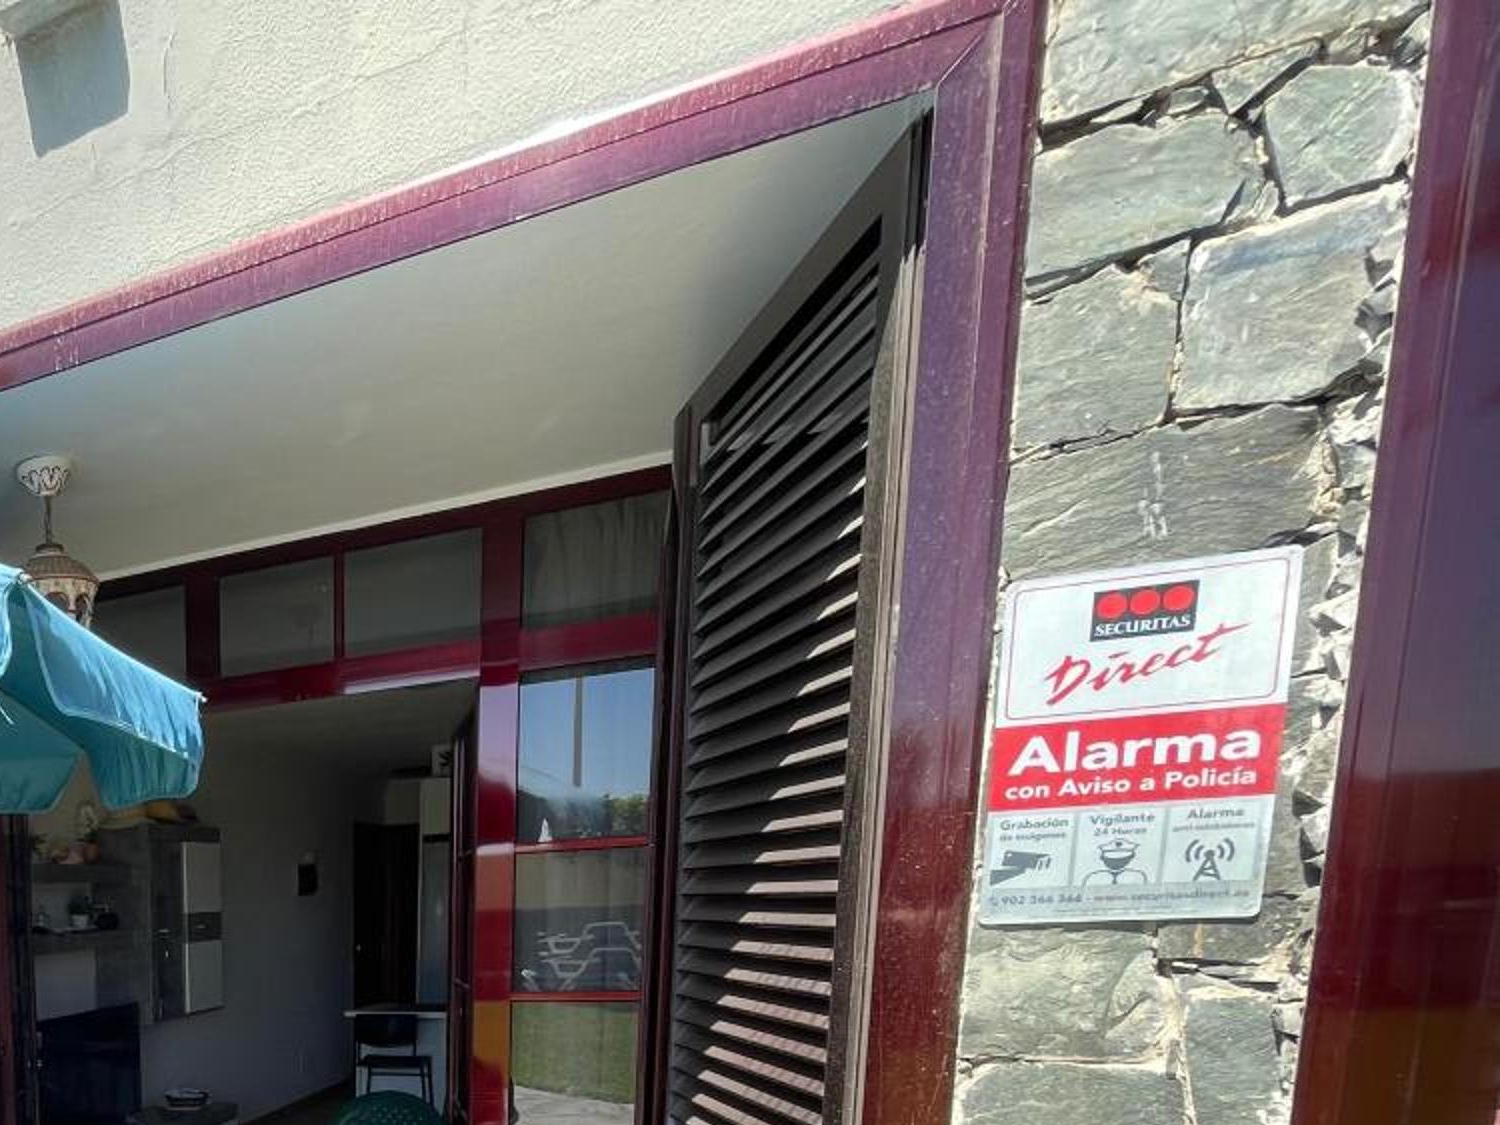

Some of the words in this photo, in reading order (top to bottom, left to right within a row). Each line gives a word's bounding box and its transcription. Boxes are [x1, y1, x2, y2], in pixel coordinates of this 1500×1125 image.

[1094, 617, 1192, 636] SECURITAS
[1043, 622, 1251, 706] Direct
[1007, 729, 1262, 777] Alarma
[1004, 783, 1050, 800] con
[1058, 776, 1132, 797] Aviso
[1139, 779, 1156, 792] a
[1163, 765, 1258, 789] Policía
[1089, 813, 1156, 827] Vigilante
[1187, 807, 1246, 820] Alarma
[999, 817, 1070, 831] Grabación
